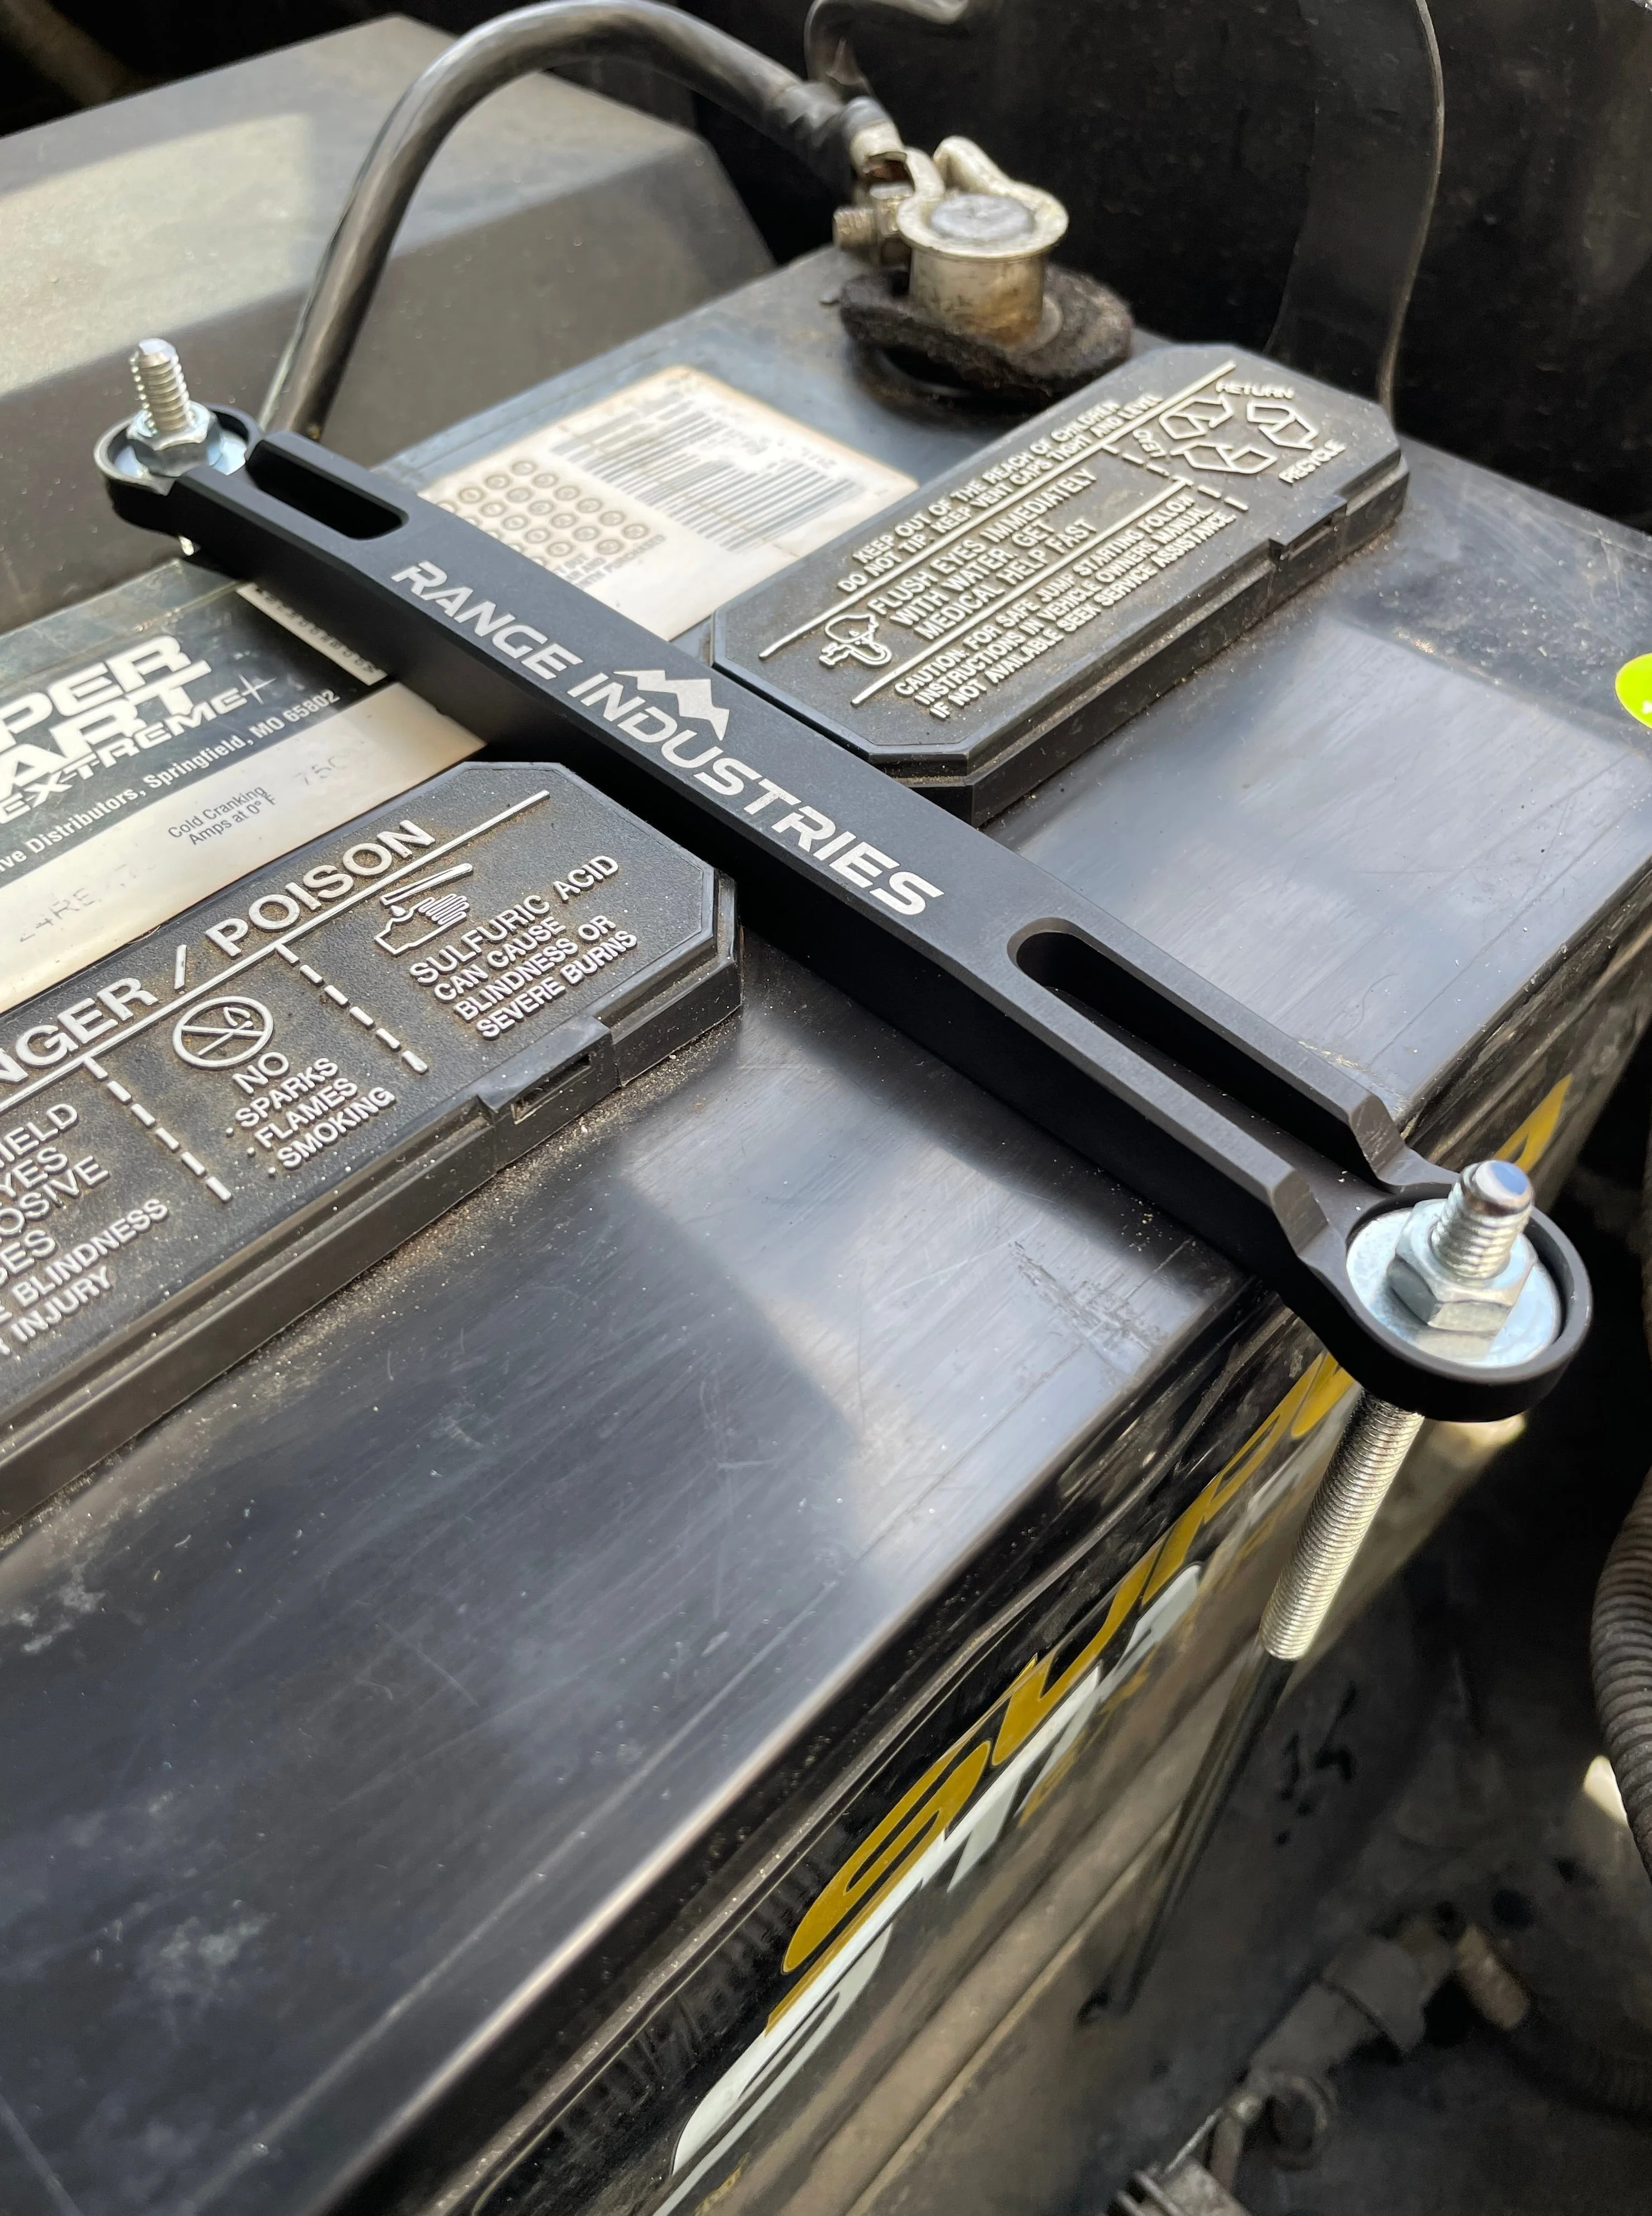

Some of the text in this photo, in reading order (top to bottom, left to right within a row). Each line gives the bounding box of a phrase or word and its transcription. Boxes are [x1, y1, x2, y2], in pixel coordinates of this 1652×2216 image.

[1215, 379, 1295, 399] RETURN
[838, 573, 869, 593] DO
[863, 550, 903, 577] NOT
[929, 507, 973, 534] KEEP
[970, 482, 1014, 508] VENT
[1009, 458, 1054, 485] CAPS
[1090, 414, 1125, 439] AND
[852, 534, 896, 564] KEEP
[895, 513, 932, 538] OUT
[928, 499, 953, 516] OF
[951, 480, 987, 502] THE
[981, 451, 1034, 485] REACH
[1278, 439, 1347, 484] RECYCLE
[867, 465, 1097, 616] FLUSH EYES IMMEDIATELY
[890, 590, 950, 626] WITH
[1011, 518, 1055, 548] GET
[914, 517, 1097, 640] MEDICAL HELP FAST
[963, 624, 1003, 650] FOR
[995, 598, 1041, 628] SAFE
[1036, 573, 1075, 602] JUMP
[1073, 529, 1145, 577] STARTING
[1137, 494, 1196, 534] FOLLOW
[914, 630, 1027, 706] INSTRUCTIONS
[1018, 619, 1045, 636] IN
[1037, 579, 1103, 621] VEHICLE
[1094, 540, 1159, 583] OWNERS
[929, 701, 951, 720] IF
[947, 678, 987, 708] NOT
[984, 629, 1065, 686] AVAILABLE
[1056, 604, 1102, 633] SEEK
[1093, 562, 1159, 606] SERVICE
[143, 733, 254, 788] Springfield,
[250, 716, 286, 745] MO
[284, 689, 340, 726] 65802
[391, 560, 583, 680] RANGE
[567, 672, 945, 916] INDUSTRIES
[168, 815, 204, 838] Cold
[202, 786, 268, 821] Cranking
[188, 820, 232, 846] Amps
[232, 809, 249, 823] at
[263, 793, 276, 806] F
[206, 819, 436, 956] POISON
[409, 855, 619, 987] SULFURIC ACID
[433, 915, 568, 1003] CAN CAUSE
[454, 914, 617, 1022] BLINDNESS OR
[476, 930, 638, 1040] SEVERE BURNS
[232, 1052, 290, 1095] NO
[235, 1057, 339, 1128] SPARKS
[253, 1077, 358, 1150] FLAMES
[276, 1086, 396, 1169] SMOKING
[11, 1265, 111, 1342] INJURY
[12, 1198, 168, 1308] BLINDNESS
